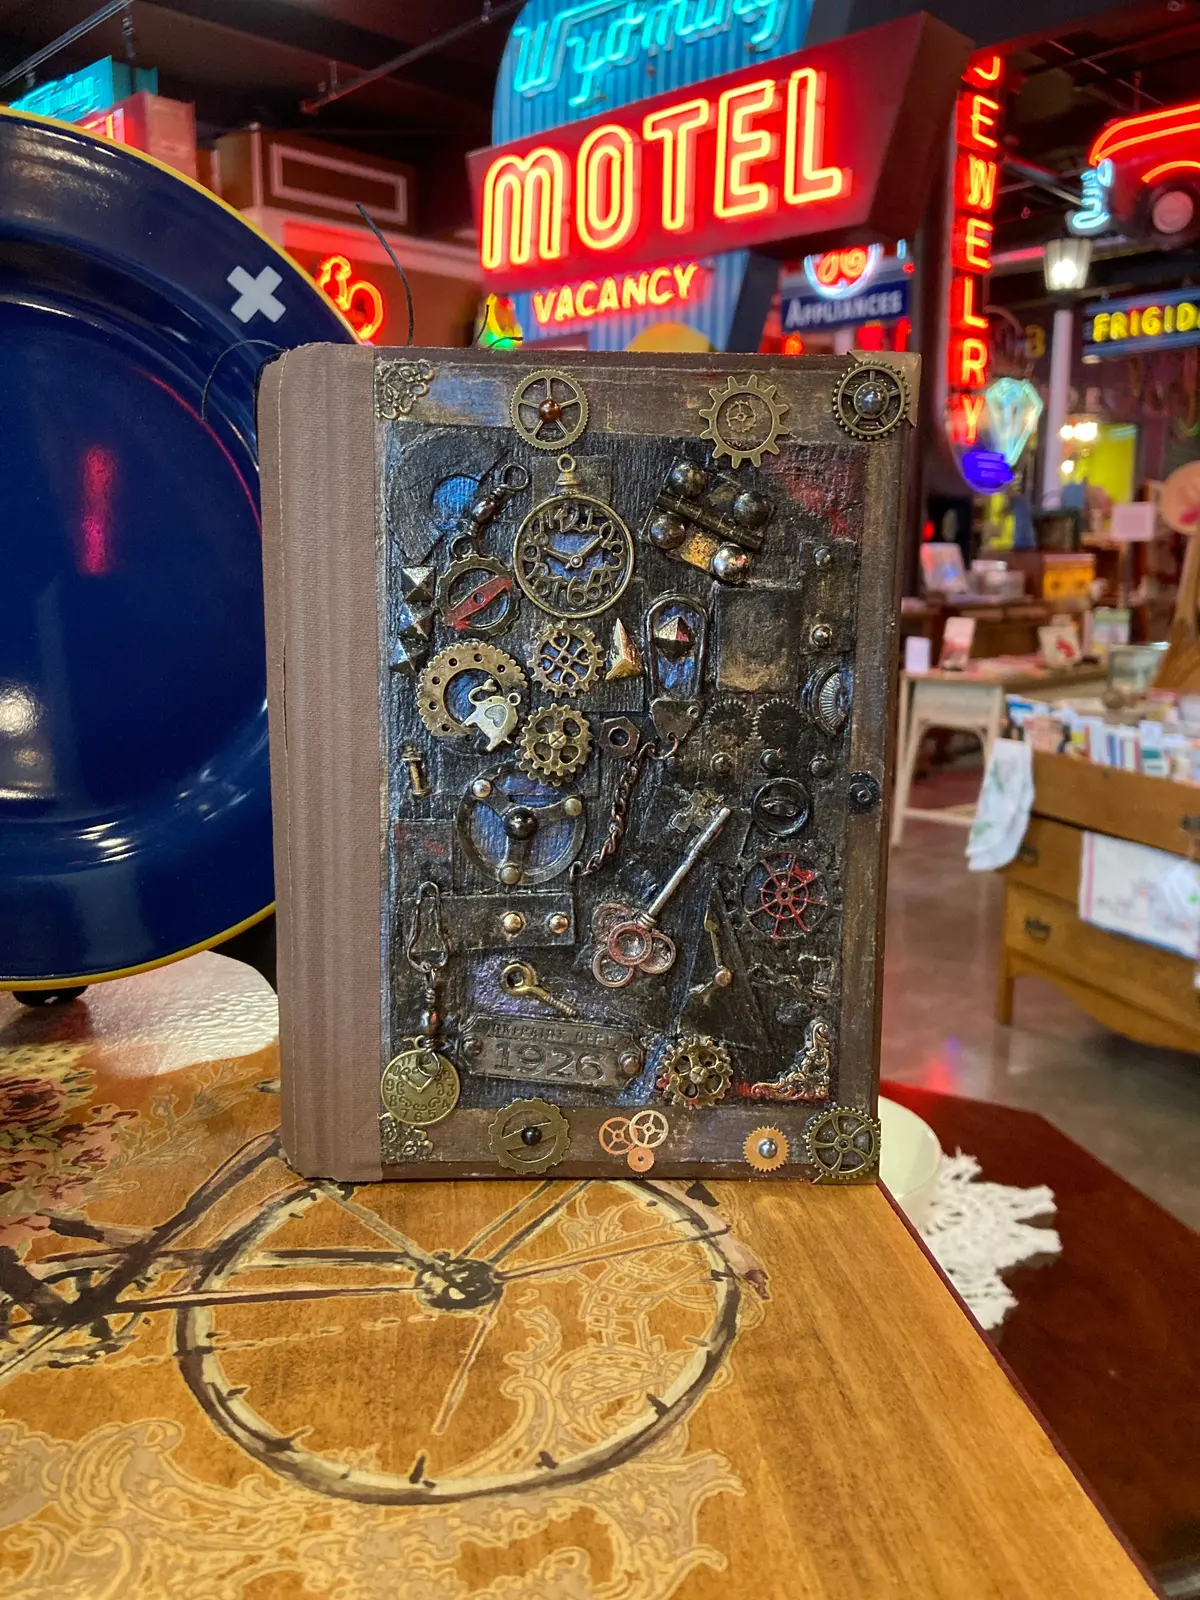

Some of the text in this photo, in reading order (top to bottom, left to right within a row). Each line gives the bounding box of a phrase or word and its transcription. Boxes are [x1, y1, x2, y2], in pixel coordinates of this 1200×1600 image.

[481, 67, 843, 270] MOTEL
[532, 262, 700, 325] VACANCY
[1092, 302, 1200, 343] FRIGID
[493, 1041, 606, 1084] 1926
